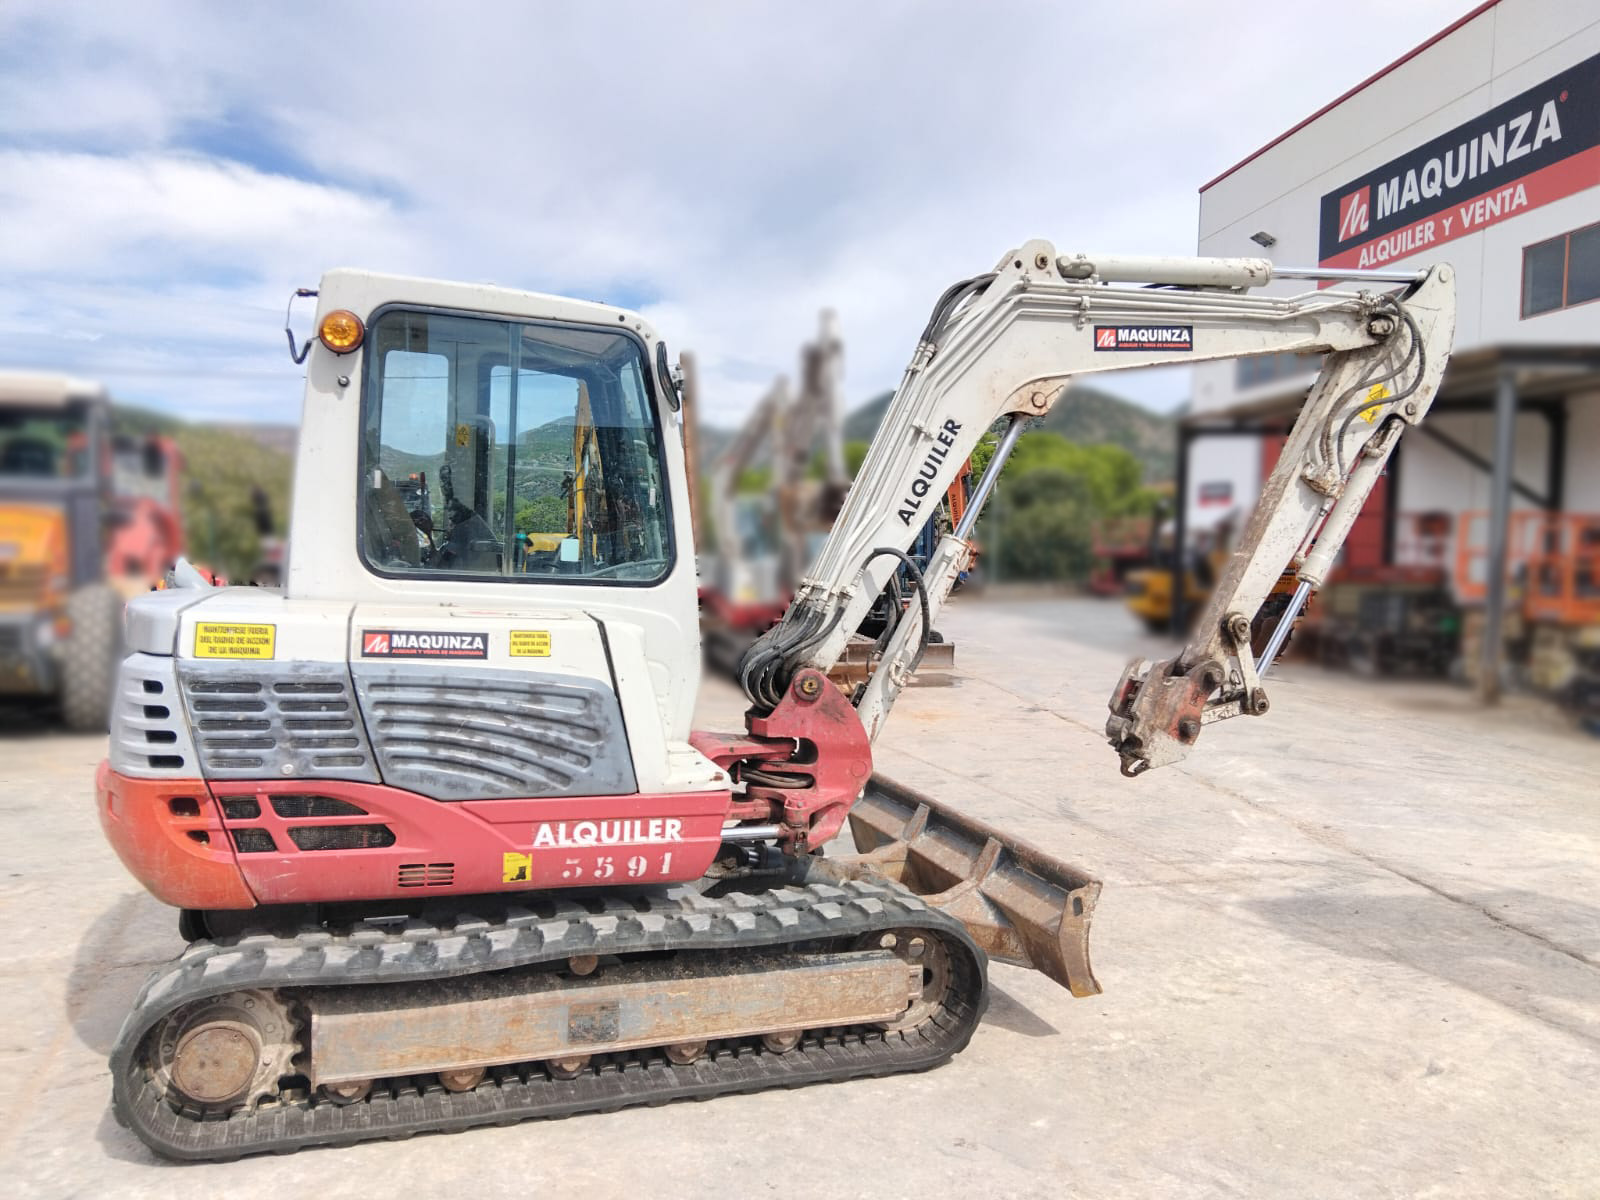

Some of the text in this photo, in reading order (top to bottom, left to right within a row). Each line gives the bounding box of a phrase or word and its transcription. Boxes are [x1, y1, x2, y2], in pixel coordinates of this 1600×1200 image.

[1377, 99, 1562, 220] MAQUINZA
[1358, 183, 1529, 269] ALQUILER Y VENTA
[1118, 329, 1191, 342] MAQUINZA
[897, 418, 964, 527] ALQUILER
[391, 634, 485, 650] MAQUINZA
[533, 818, 682, 848] ALQUILER
